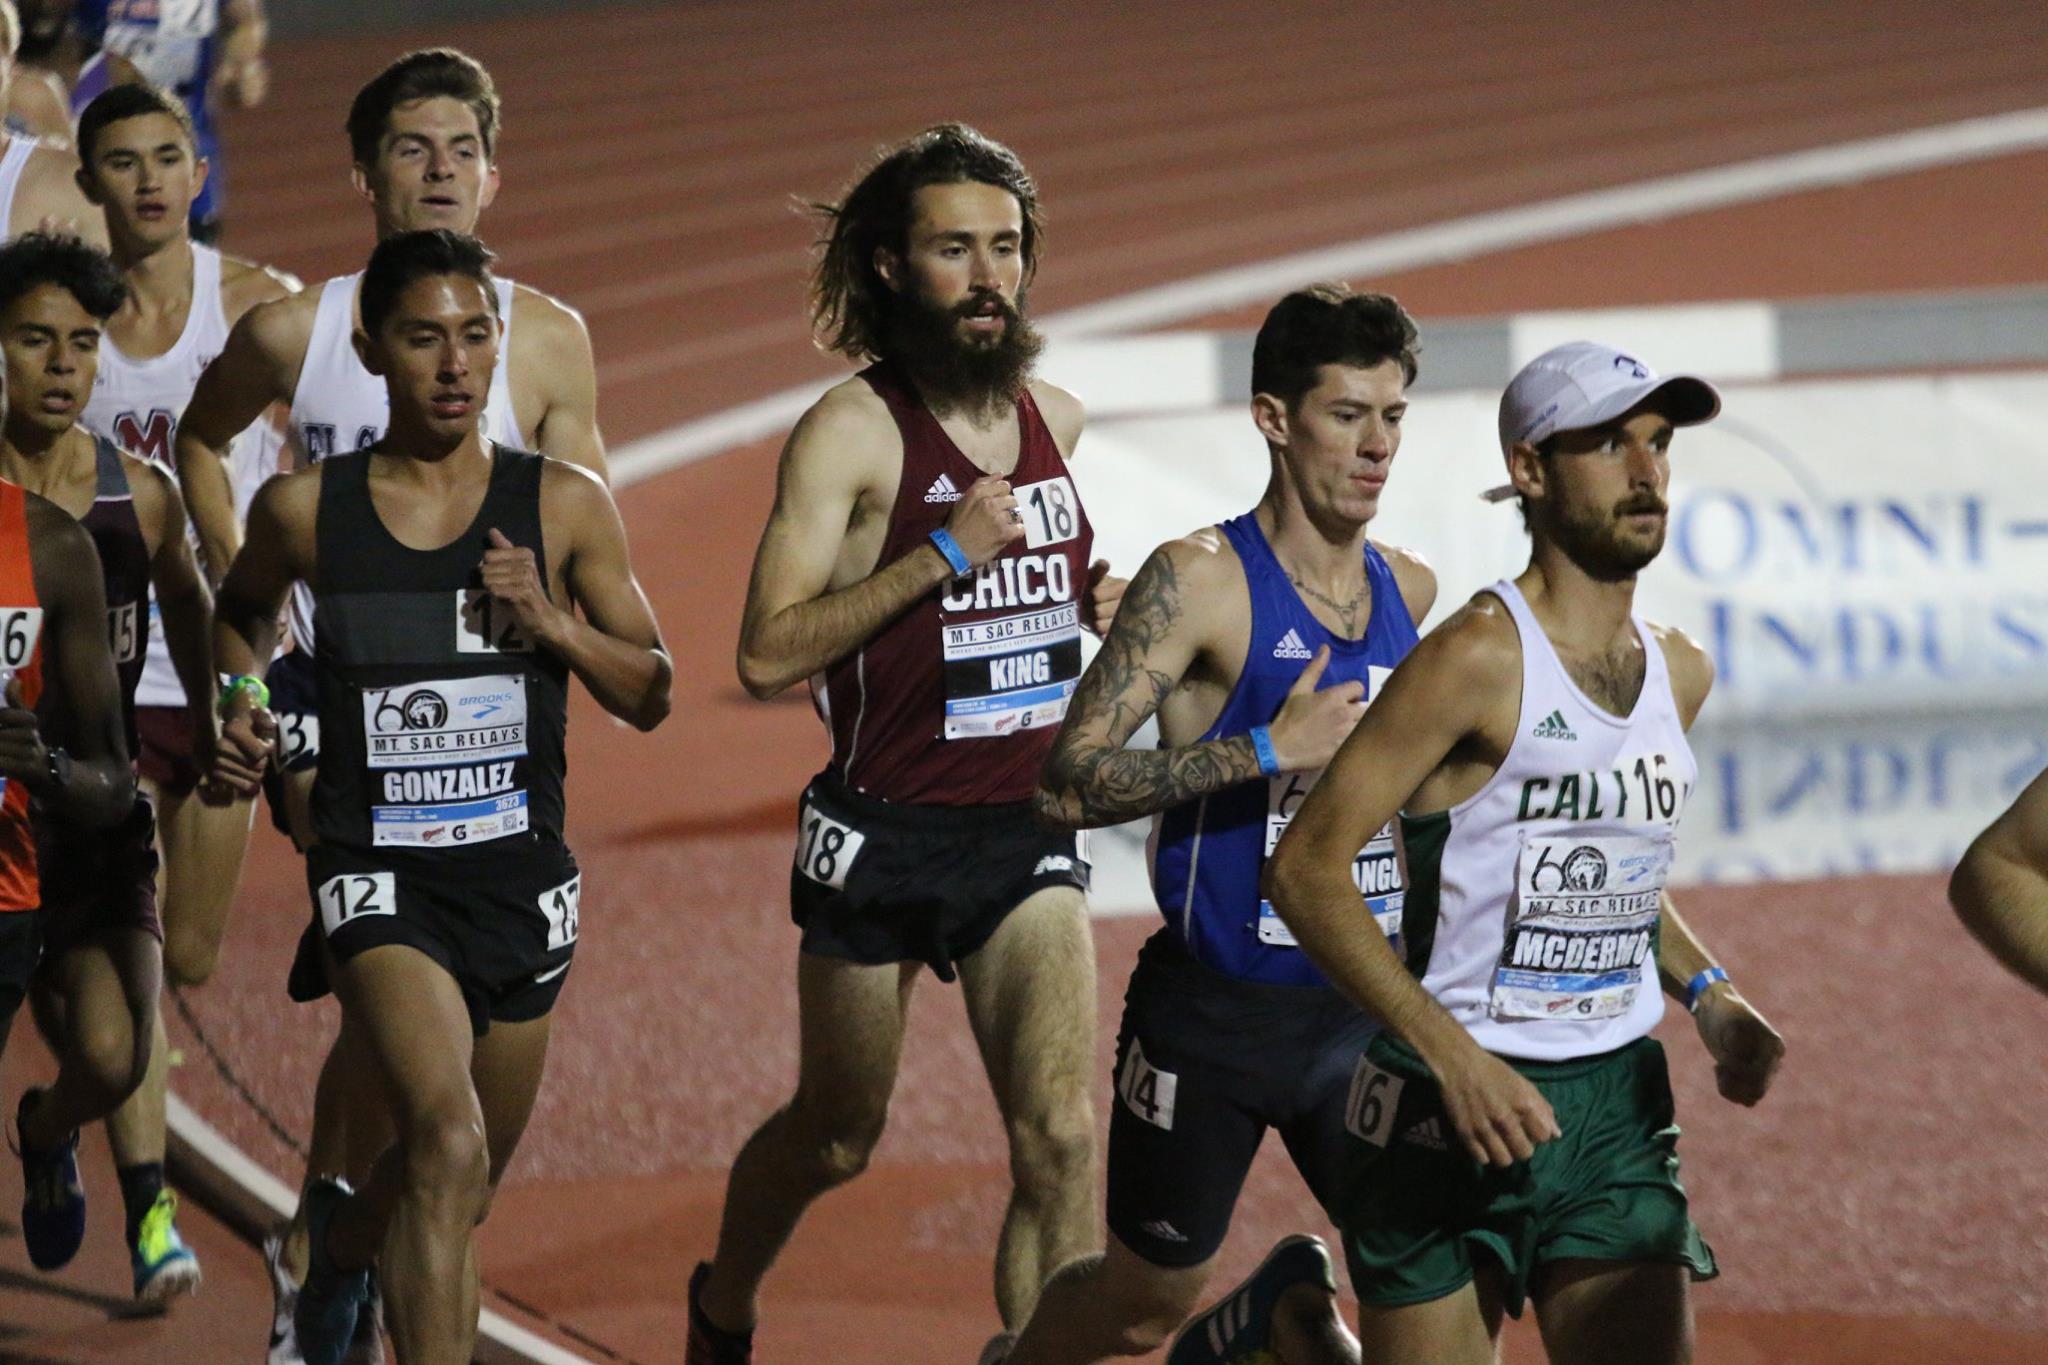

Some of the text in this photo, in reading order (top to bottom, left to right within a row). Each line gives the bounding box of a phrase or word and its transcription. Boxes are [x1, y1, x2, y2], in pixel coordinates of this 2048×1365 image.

[924, 491, 962, 503] adidas
[1029, 482, 1072, 541] 18
[941, 553, 1071, 612] CHICO
[986, 622, 1014, 640] SAC
[1023, 609, 1074, 633] RELAYS
[990, 651, 1049, 691] KING
[1273, 648, 1312, 659] adidas
[459, 692, 512, 706] BROOKS
[410, 736, 445, 751] SAC
[457, 728, 519, 747] RELAYS
[1533, 728, 1577, 741] adidas
[384, 761, 515, 803] GONZALEZ
[1634, 754, 1676, 821] 16
[803, 817, 845, 882] 18
[328, 876, 381, 922] 12
[1565, 900, 1600, 914] SAC
